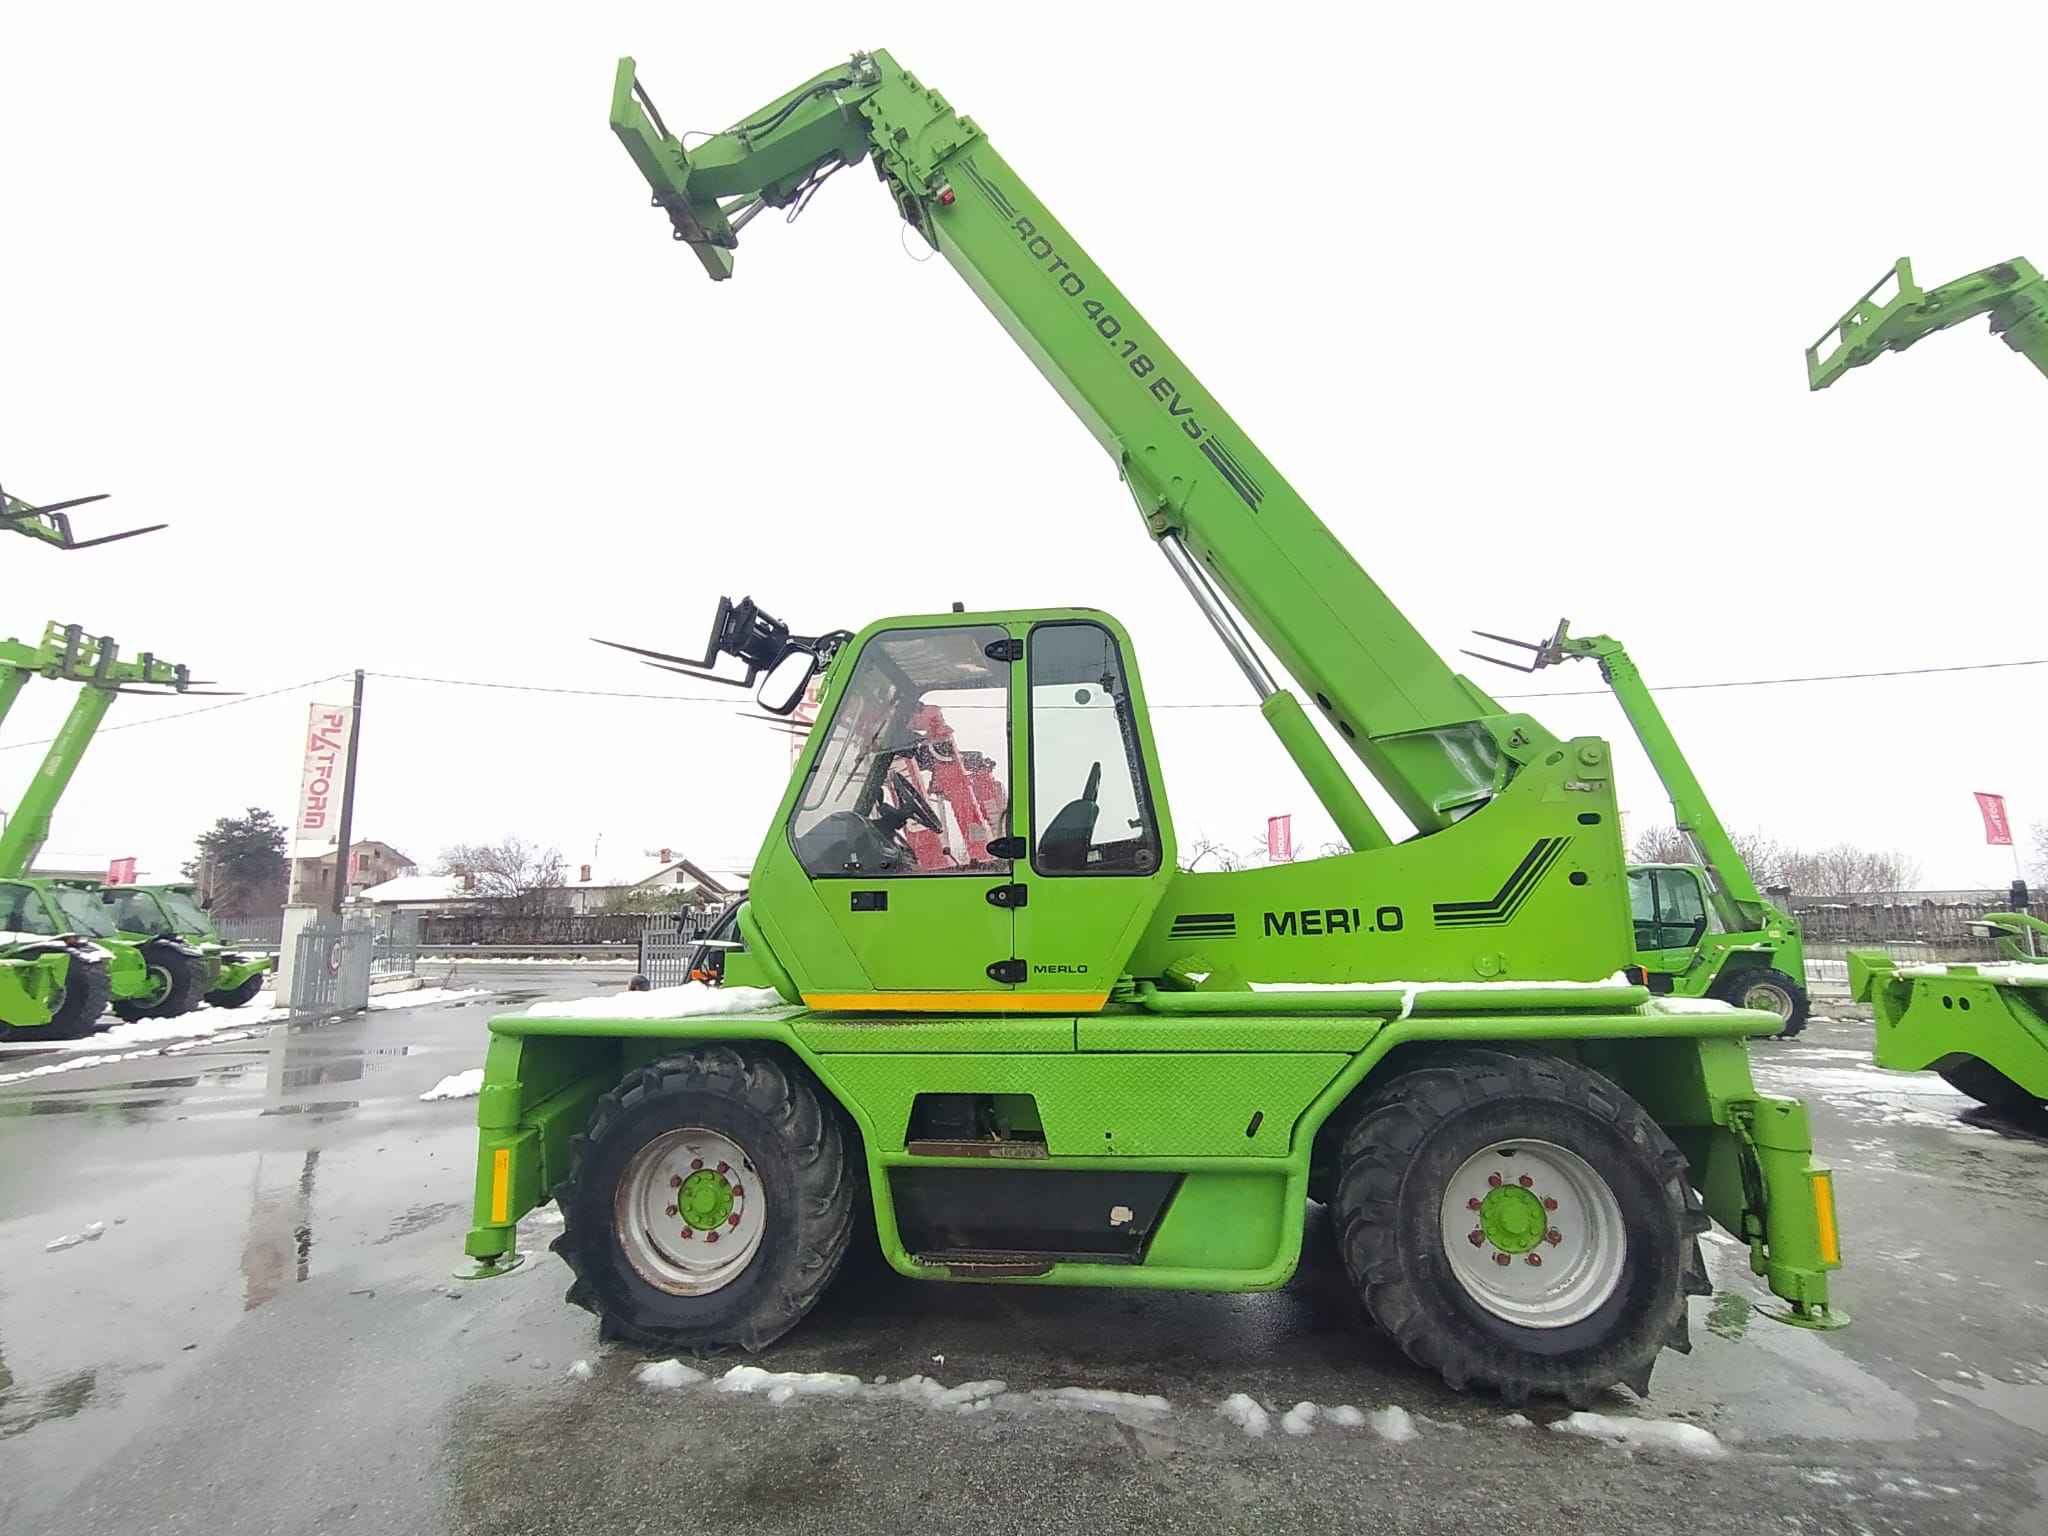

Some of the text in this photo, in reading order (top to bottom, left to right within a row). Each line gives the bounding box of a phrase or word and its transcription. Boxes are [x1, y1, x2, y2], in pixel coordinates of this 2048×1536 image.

[1011, 216, 1208, 440] ROTO 40.18 EVS
[303, 714, 344, 829] PLATFORM
[1033, 964, 1088, 974] MERLO
